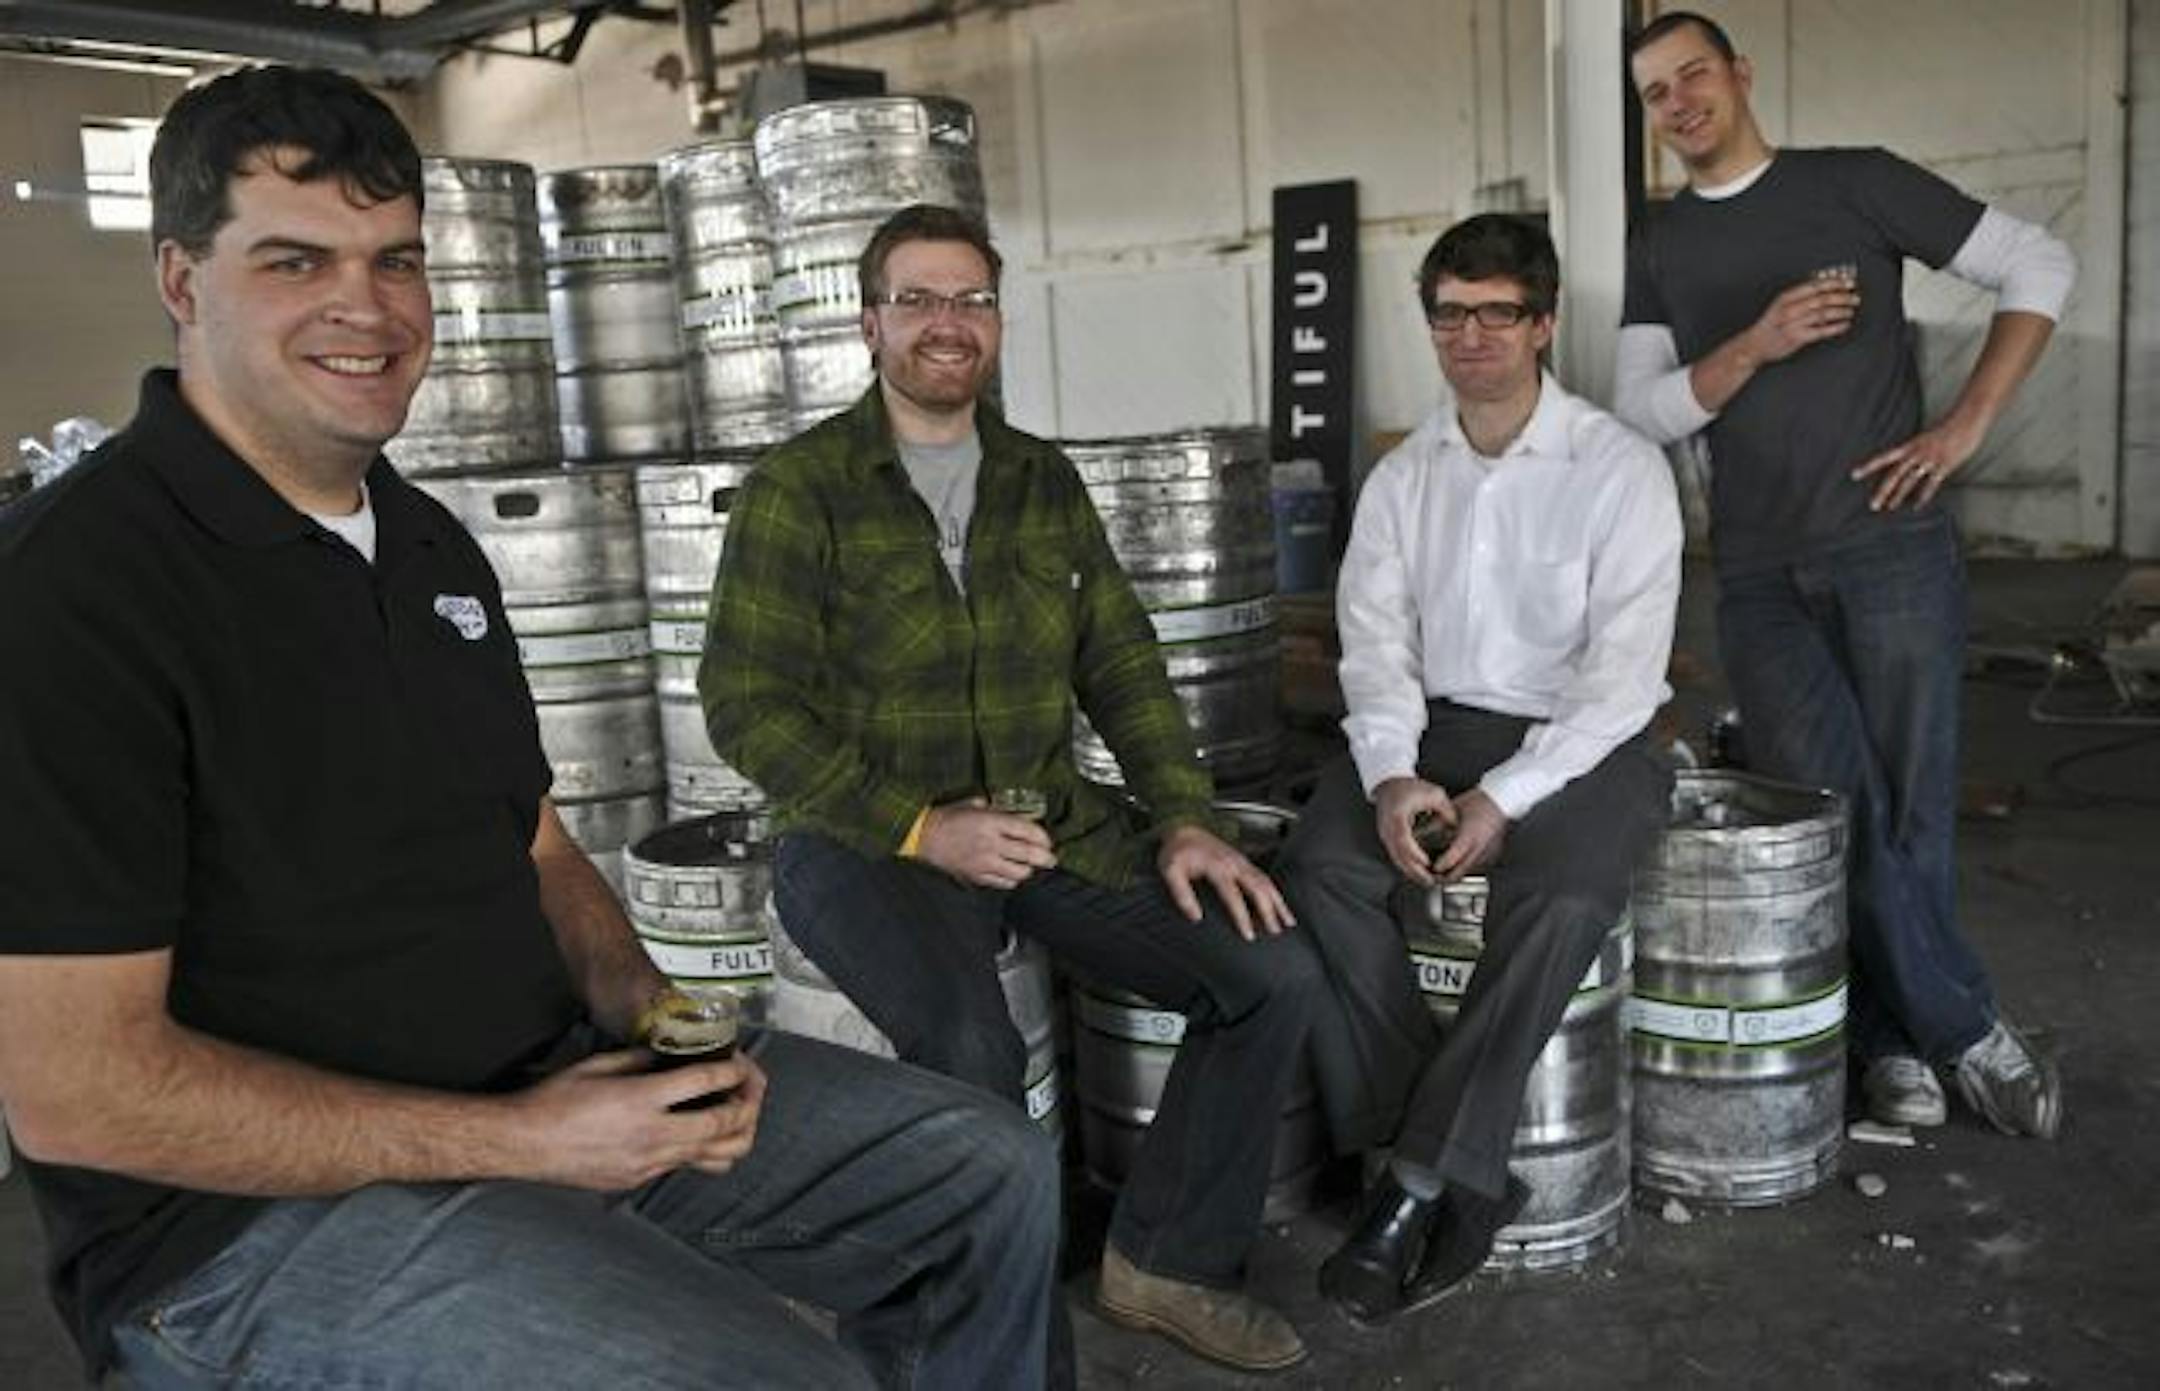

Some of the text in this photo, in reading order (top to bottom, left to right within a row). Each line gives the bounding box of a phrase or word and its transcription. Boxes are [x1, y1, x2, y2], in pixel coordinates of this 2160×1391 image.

[572, 237, 643, 255] FULON
[1291, 222, 1329, 439] TIFUL
[711, 948, 768, 970] FULT
